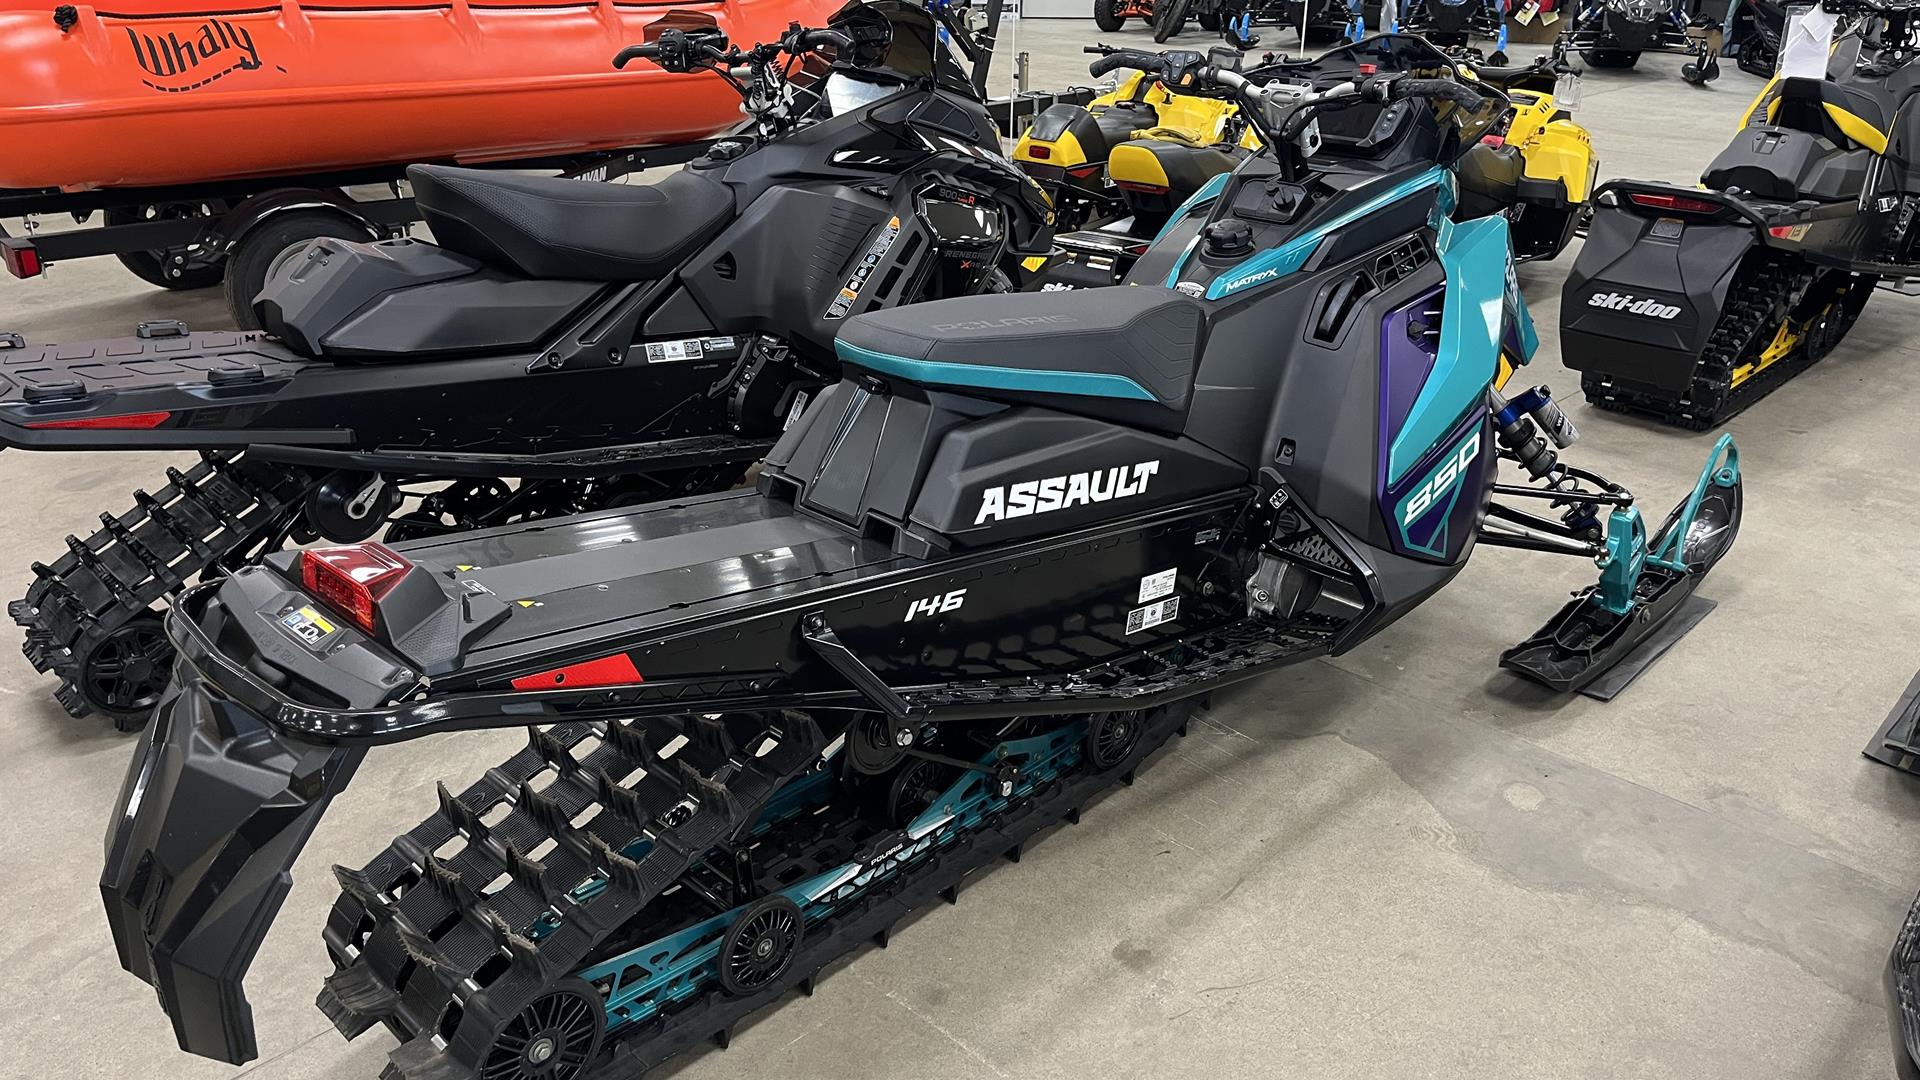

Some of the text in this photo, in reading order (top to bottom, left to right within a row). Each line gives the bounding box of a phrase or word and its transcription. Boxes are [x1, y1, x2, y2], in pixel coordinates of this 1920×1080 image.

[126, 18, 262, 76] Whaly
[939, 187, 958, 200] 900
[1225, 267, 1278, 293] MATRYX
[1587, 292, 1682, 320] ski-doo
[928, 313, 1078, 333] POLARIS
[973, 460, 1160, 526] ASSAULT
[1403, 431, 1480, 527] 850
[903, 588, 968, 623] 146
[870, 842, 904, 866] POLARIS
